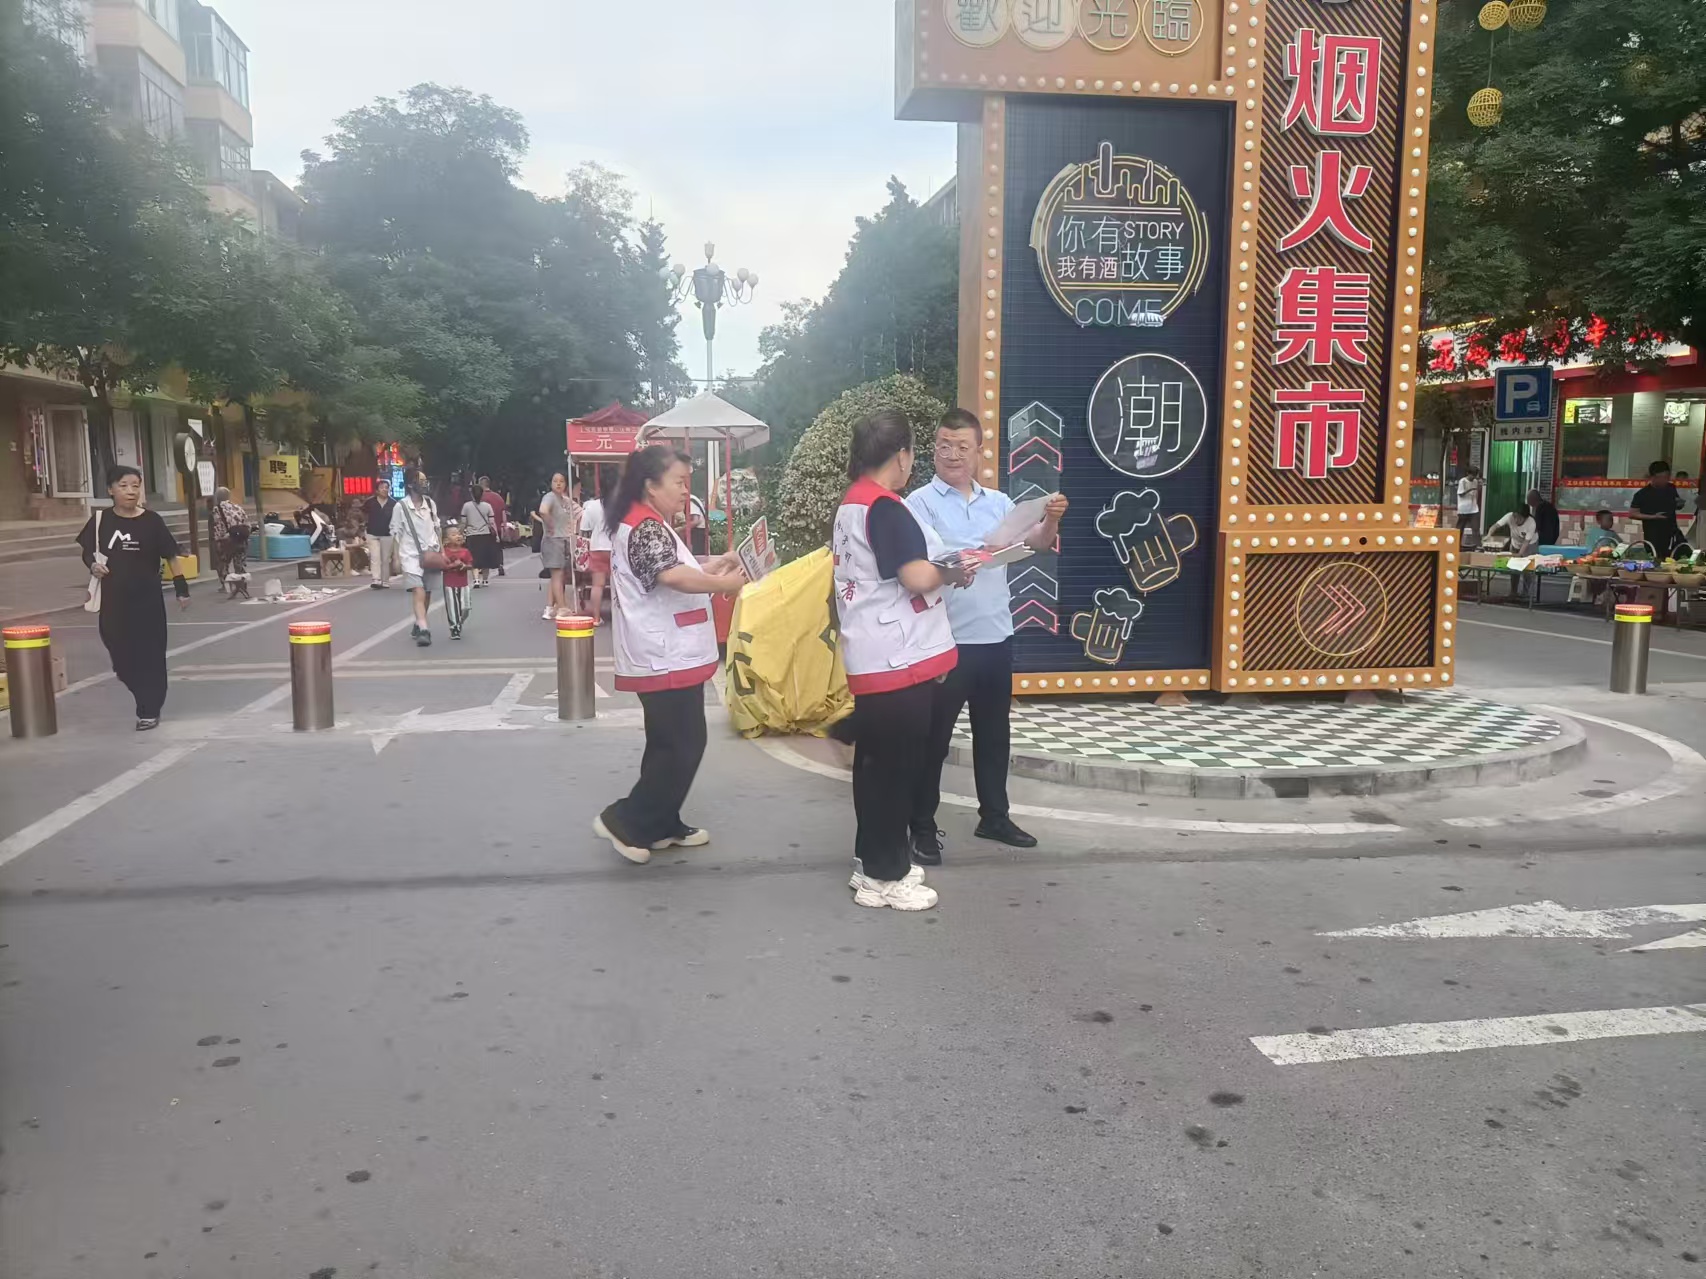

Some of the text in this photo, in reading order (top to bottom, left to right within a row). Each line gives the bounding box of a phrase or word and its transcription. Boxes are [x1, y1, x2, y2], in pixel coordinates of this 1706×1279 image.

[1057, 215, 1185, 254] 你有 STORY
[1273, 28, 1383, 479] 烟火集市
[1057, 243, 1185, 281] 我有酒 故事
[1505, 375, 1538, 413] P
[1113, 375, 1183, 456] 潮
[269, 460, 287, 474] 聘
